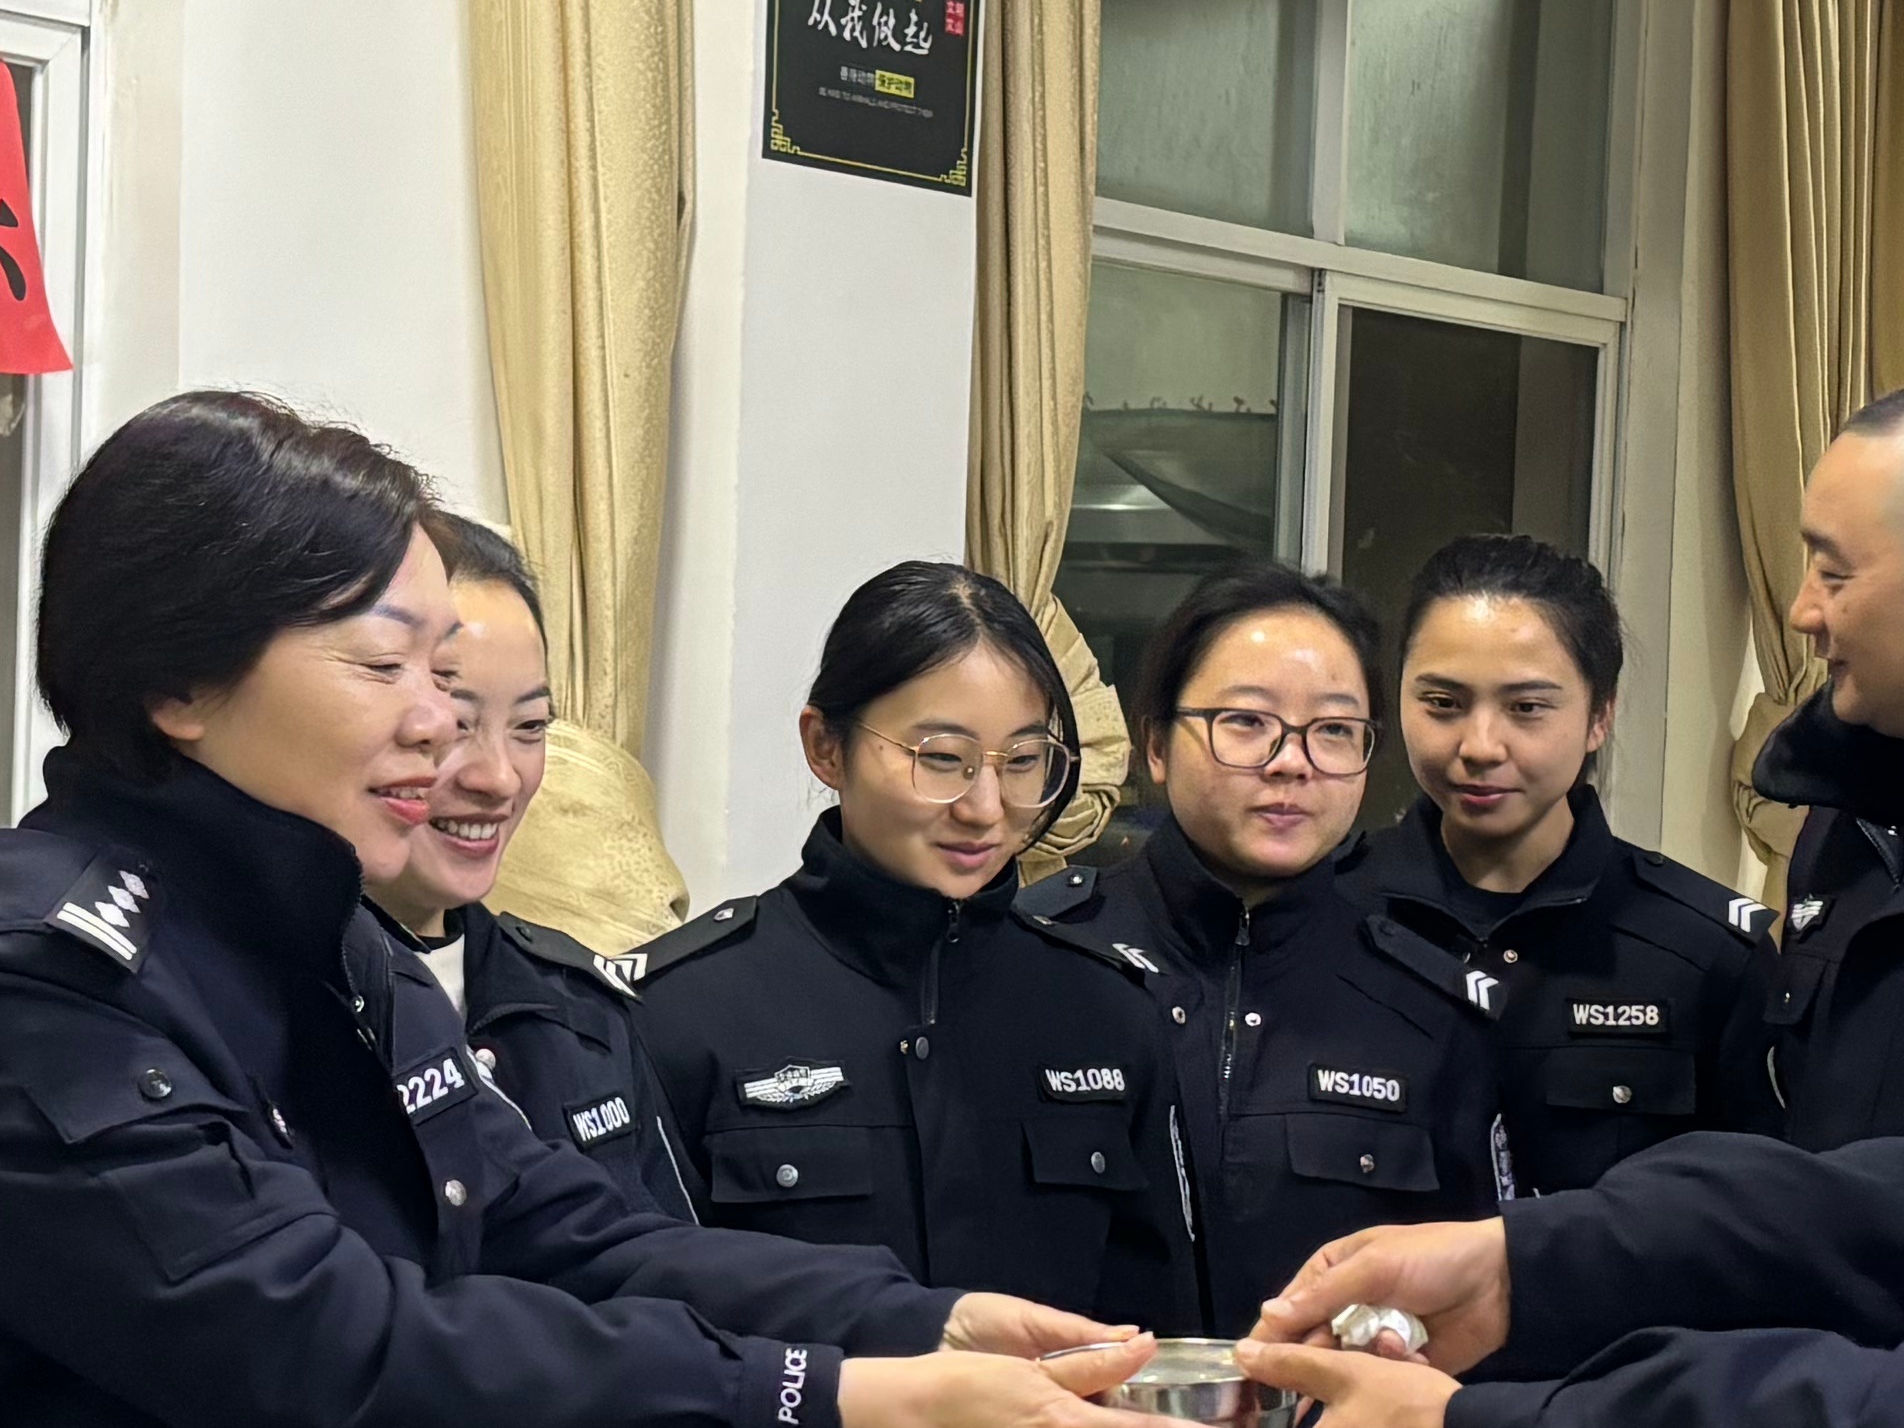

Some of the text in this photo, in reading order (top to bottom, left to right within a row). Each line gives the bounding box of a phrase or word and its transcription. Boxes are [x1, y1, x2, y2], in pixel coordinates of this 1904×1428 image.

[1573, 1003, 1659, 1026] WS1258
[1045, 1068, 1126, 1092] WS1088
[1317, 1069, 1400, 1102] WS1050
[573, 1096, 631, 1142] WS1000
[778, 1348, 808, 1425] POLICE
